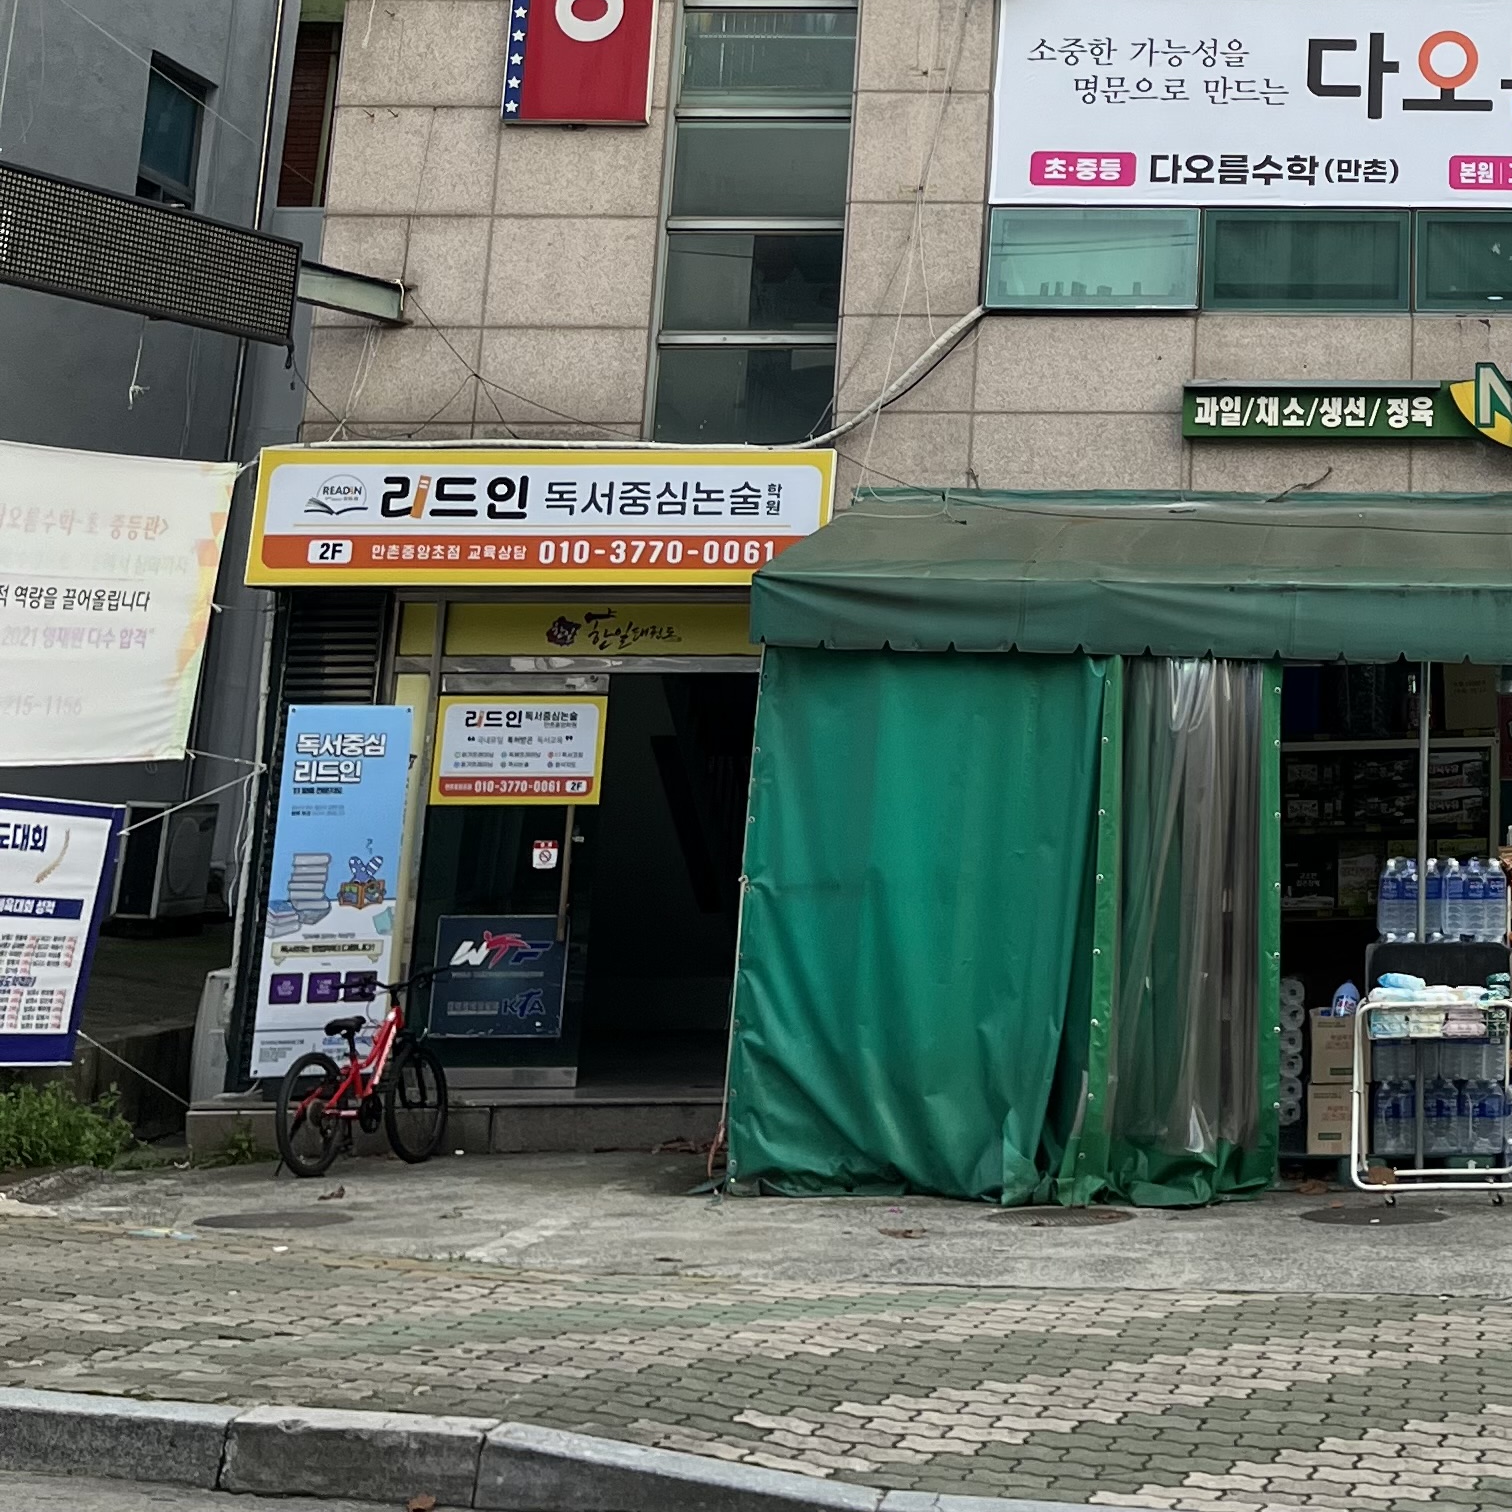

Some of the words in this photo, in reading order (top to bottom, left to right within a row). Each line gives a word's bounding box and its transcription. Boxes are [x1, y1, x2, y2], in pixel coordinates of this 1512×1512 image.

[1027, 37, 1118, 66] 소중한
[1130, 38, 1250, 68] 가능성을
[1074, 75, 1190, 105] 명문으로
[1204, 76, 1289, 106] 만드는
[1460, 162, 1494, 184] 본원
[381, 475, 529, 519] 리드인
[545, 481, 762, 516] 독서중심논술
[319, 543, 343, 560] 2F
[372, 544, 461, 560] 만촌중앙초점
[467, 545, 528, 561] 교육상담
[538, 539, 775, 565] 010-3770-0061
[14, 584, 58, 610] 역량을
[62, 587, 151, 612] 끌어올립니다
[465, 710, 523, 728] 리드인
[296, 733, 388, 758] 독서중심
[293, 760, 362, 784] 리드인
[474, 780, 561, 794] 010-3770-0061
